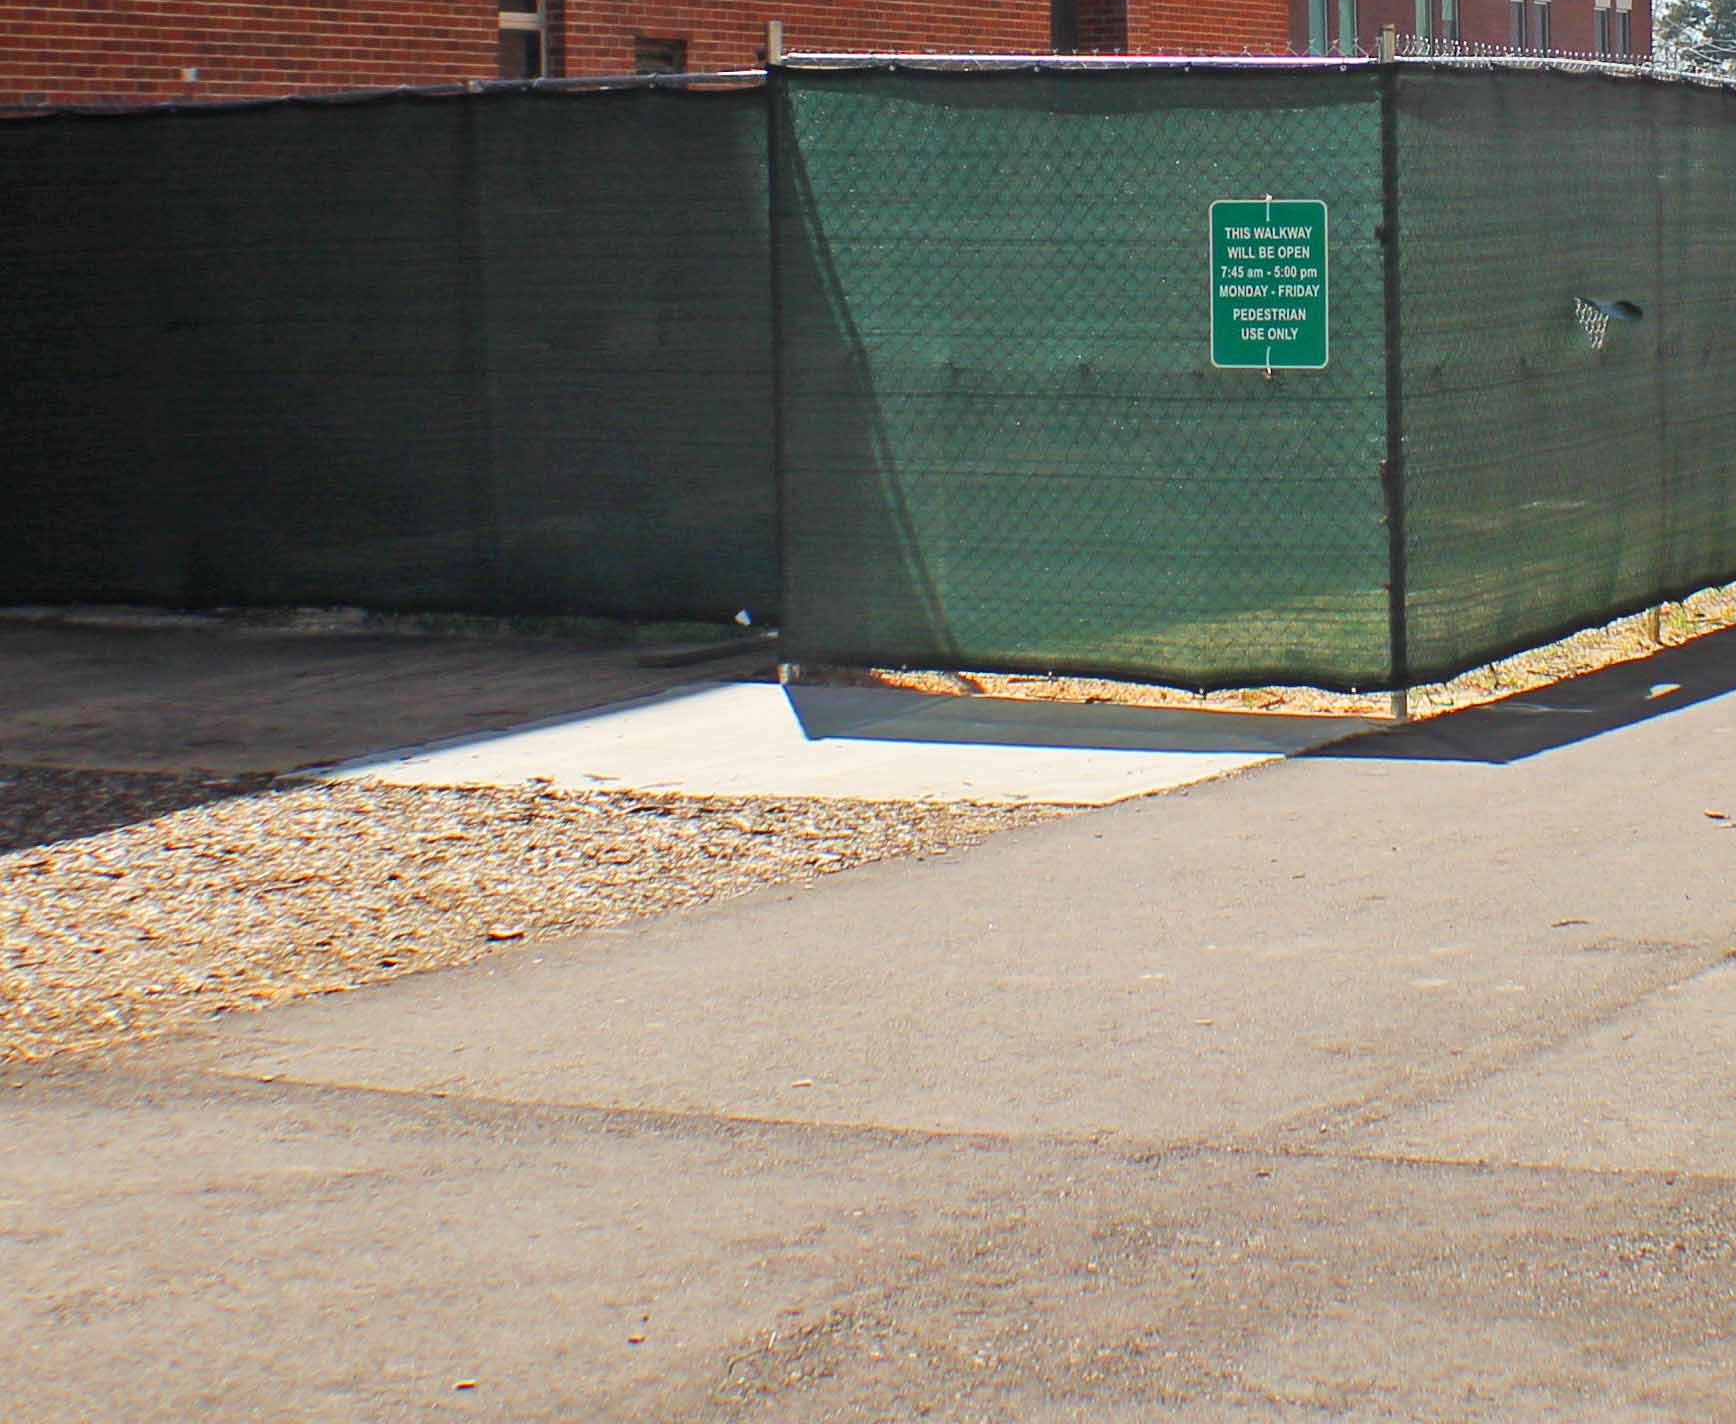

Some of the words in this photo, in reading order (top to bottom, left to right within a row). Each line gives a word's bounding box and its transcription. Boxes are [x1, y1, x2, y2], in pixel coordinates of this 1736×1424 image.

[1225, 227, 1251, 239] THIS
[1254, 227, 1312, 239] WALKWAY
[1227, 246, 1255, 258] WILL
[1259, 246, 1275, 258] BE
[1278, 246, 1310, 258] OPEN
[1221, 266, 1244, 278] 7:45
[1247, 268, 1264, 278] am
[1273, 266, 1297, 278] 5:00
[1300, 268, 1318, 280] pm
[1219, 285, 1268, 297] MONDAY
[1278, 285, 1320, 297] FRIDAY
[1233, 308, 1306, 320] PEDESTRIAN
[1241, 328, 1265, 340] USE
[1268, 328, 1298, 340] ONLY
